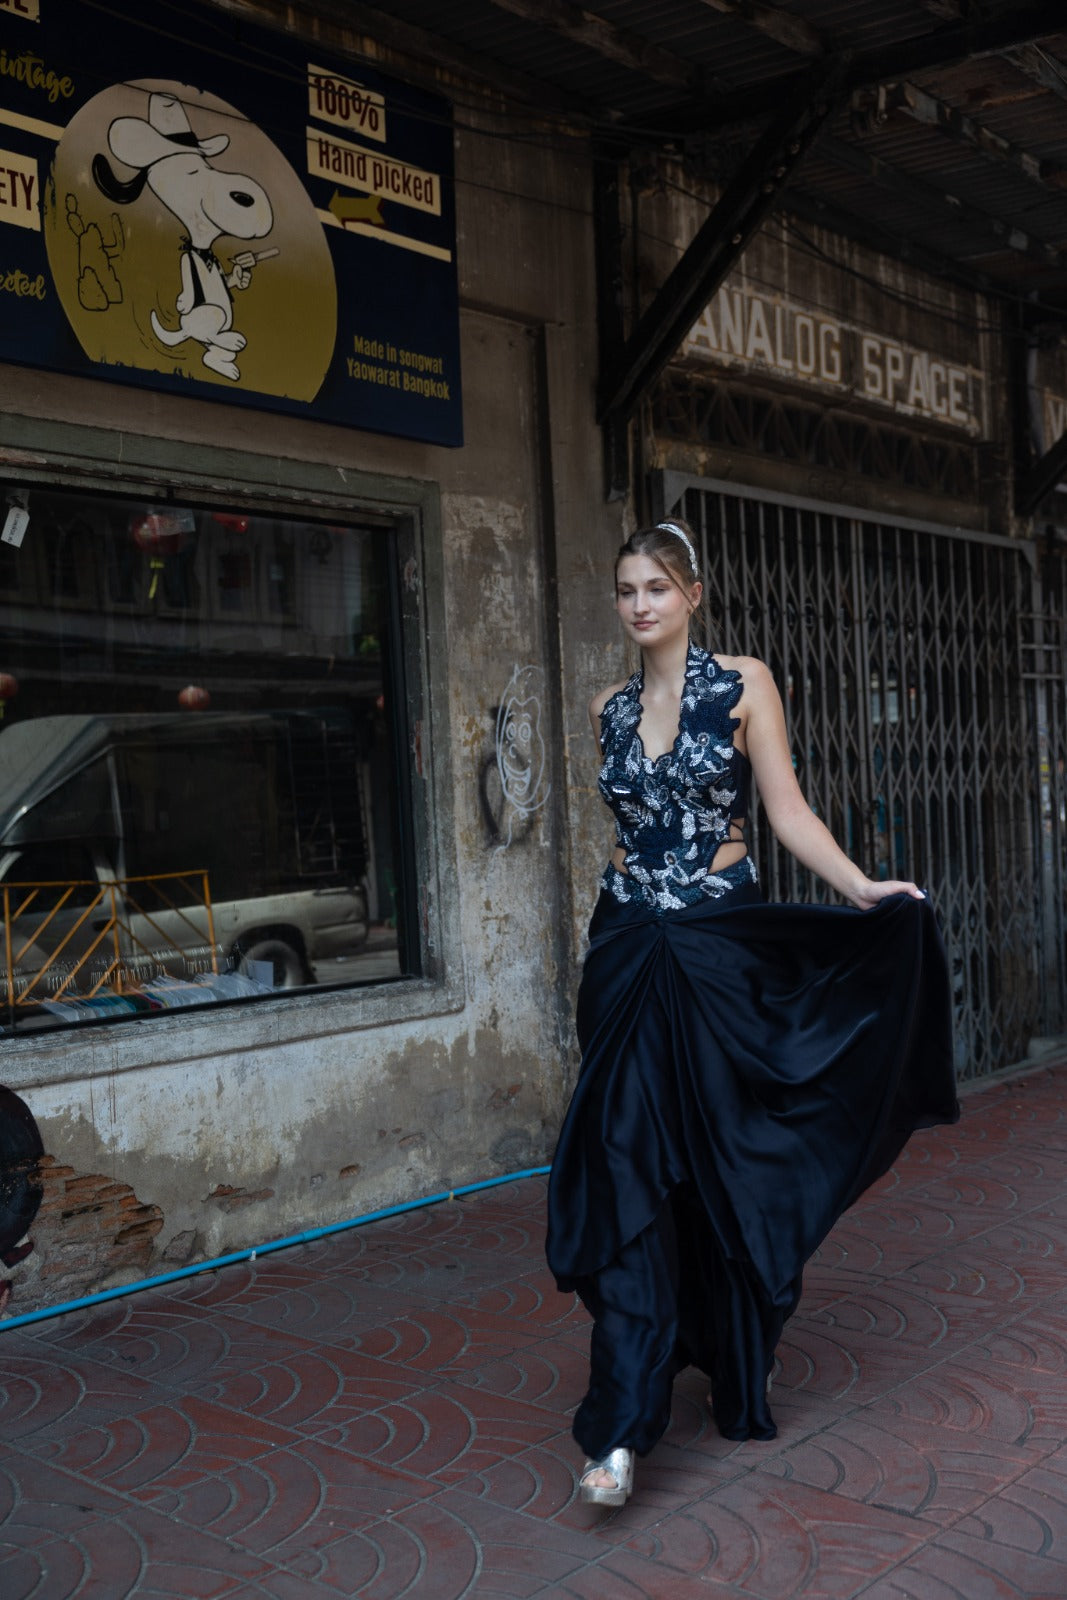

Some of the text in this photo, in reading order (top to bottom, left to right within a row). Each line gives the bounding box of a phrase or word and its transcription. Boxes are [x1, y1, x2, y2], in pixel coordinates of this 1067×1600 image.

[315, 76, 379, 132] 100%
[318, 138, 434, 206] Hand picked
[346, 356, 451, 401] Yaowarat Bangkok
[353, 335, 444, 376] Made in songwat
[688, 287, 969, 421] ANALOG SPACE
